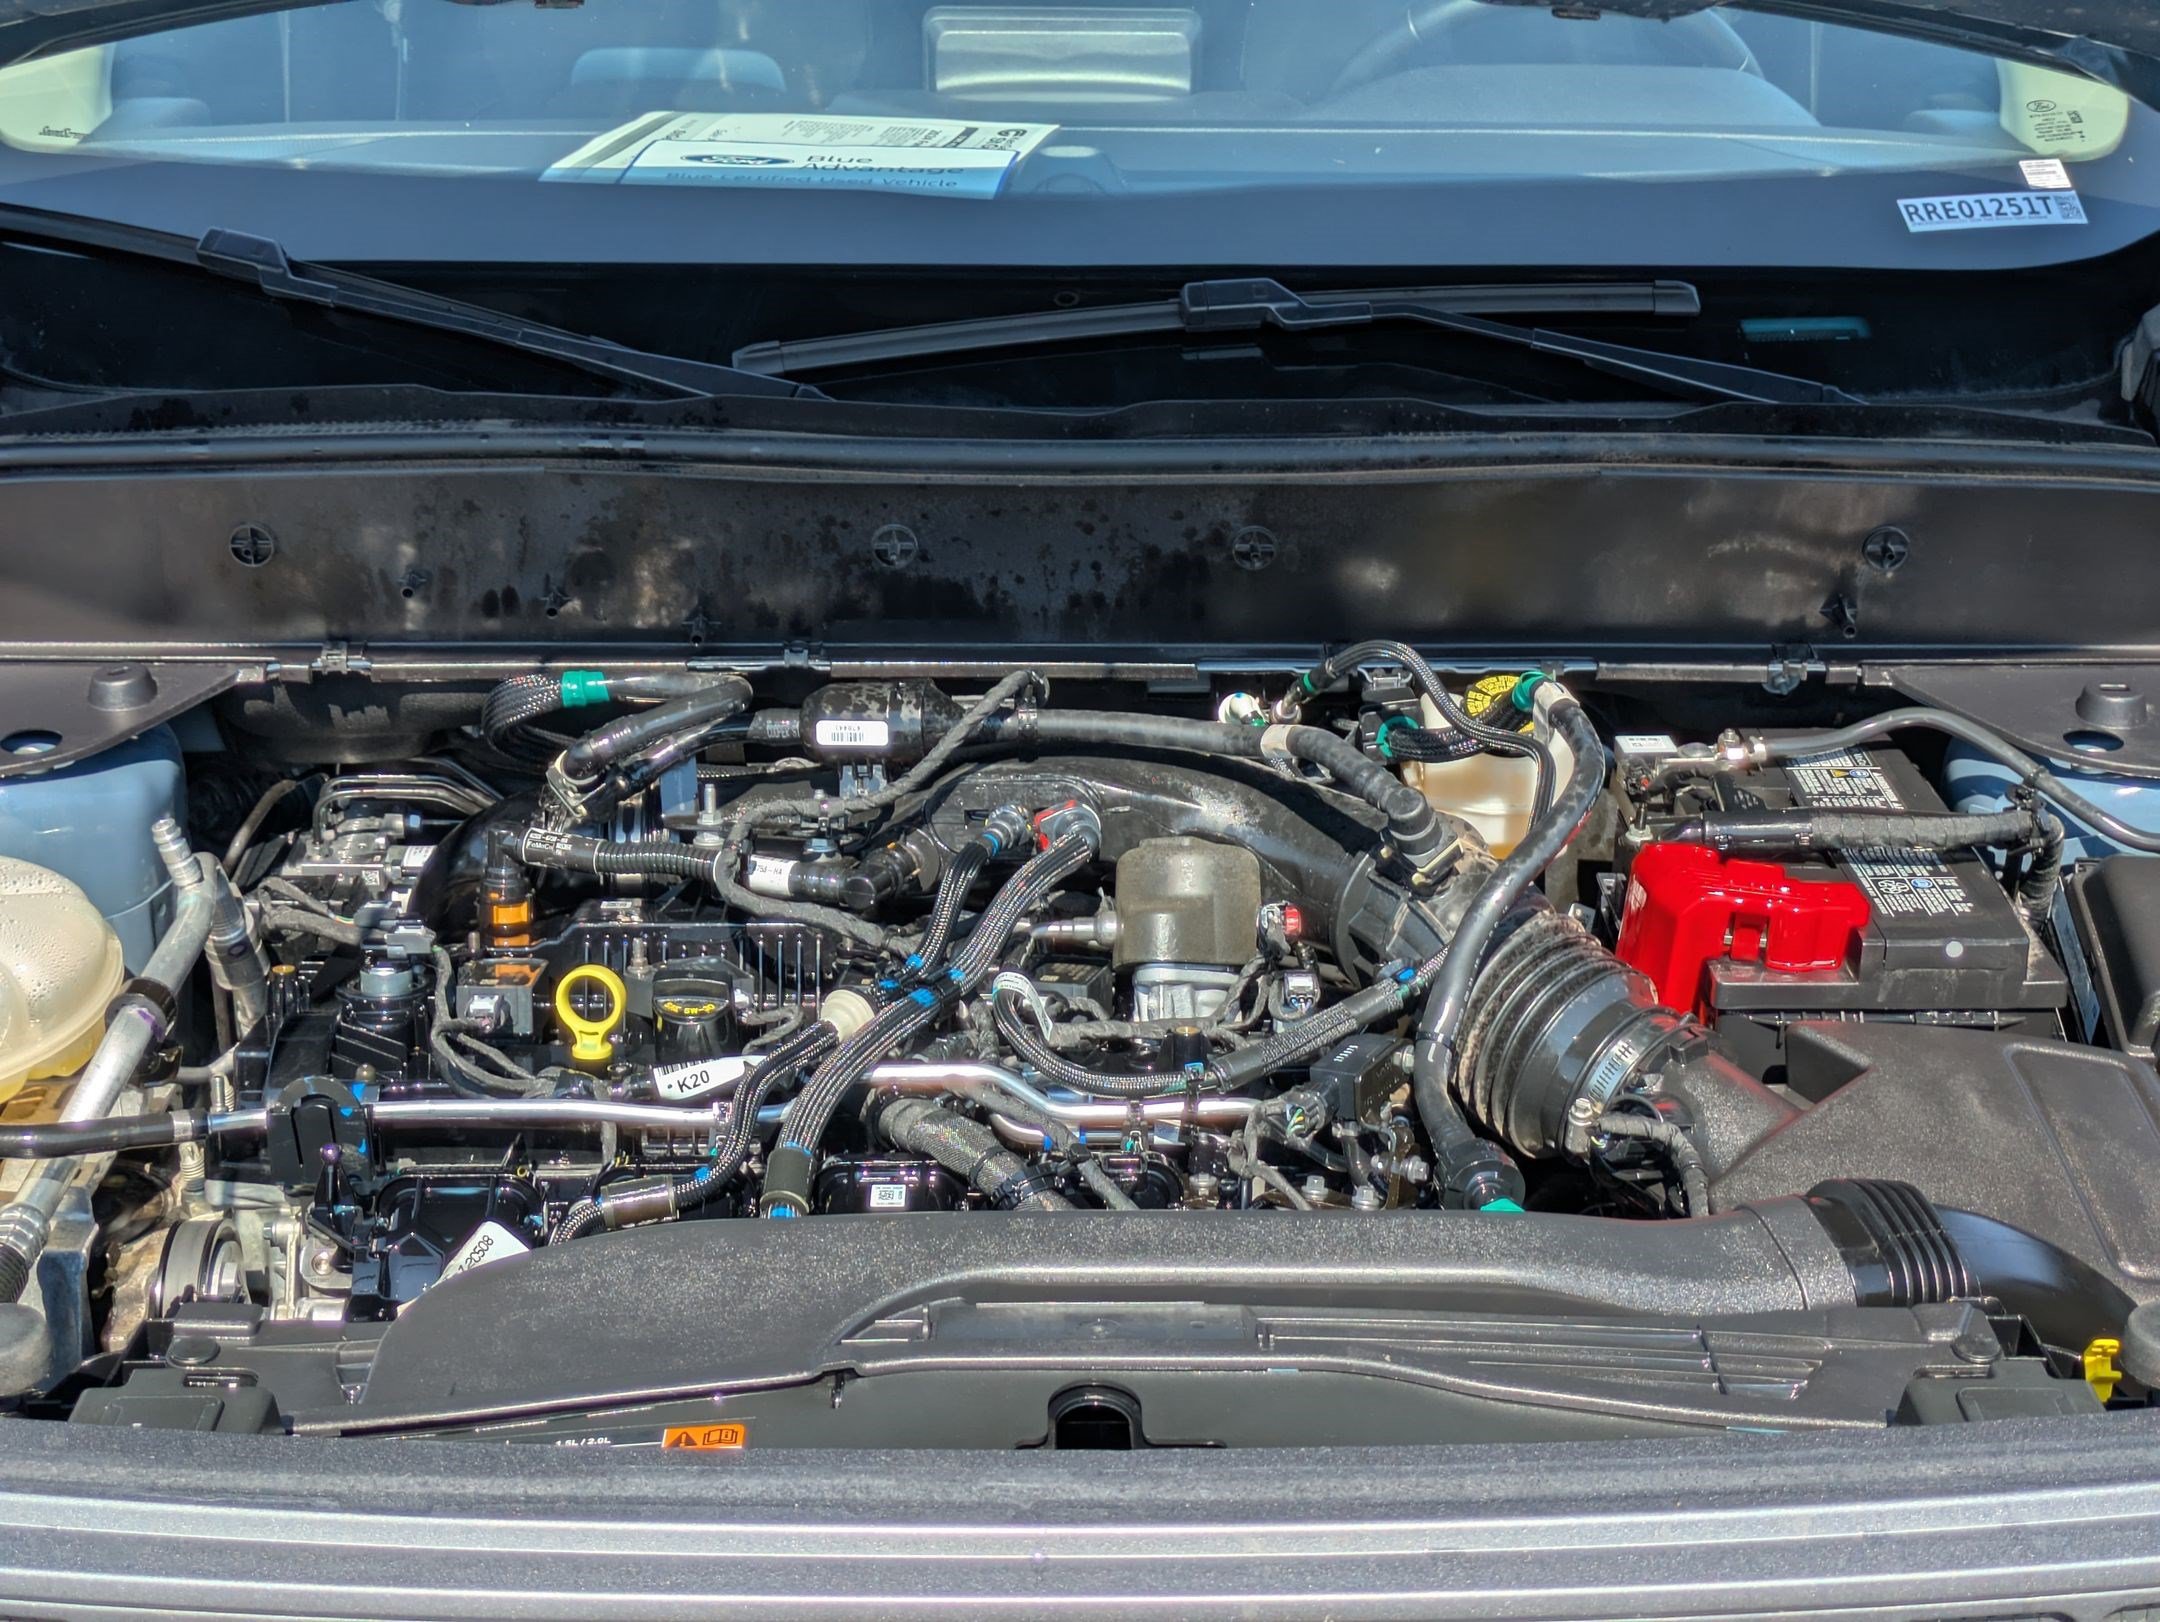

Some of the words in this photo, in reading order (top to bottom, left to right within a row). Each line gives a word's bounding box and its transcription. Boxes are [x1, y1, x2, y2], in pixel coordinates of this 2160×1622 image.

[807, 155, 873, 163] Blue
[801, 163, 965, 175] Advantage
[820, 176, 873, 186] Used
[881, 178, 958, 188] Vehicle
[1904, 196, 2052, 224] RRE01251T
[677, 1070, 710, 1093] K20
[587, 1436, 612, 1445] 2.0L
